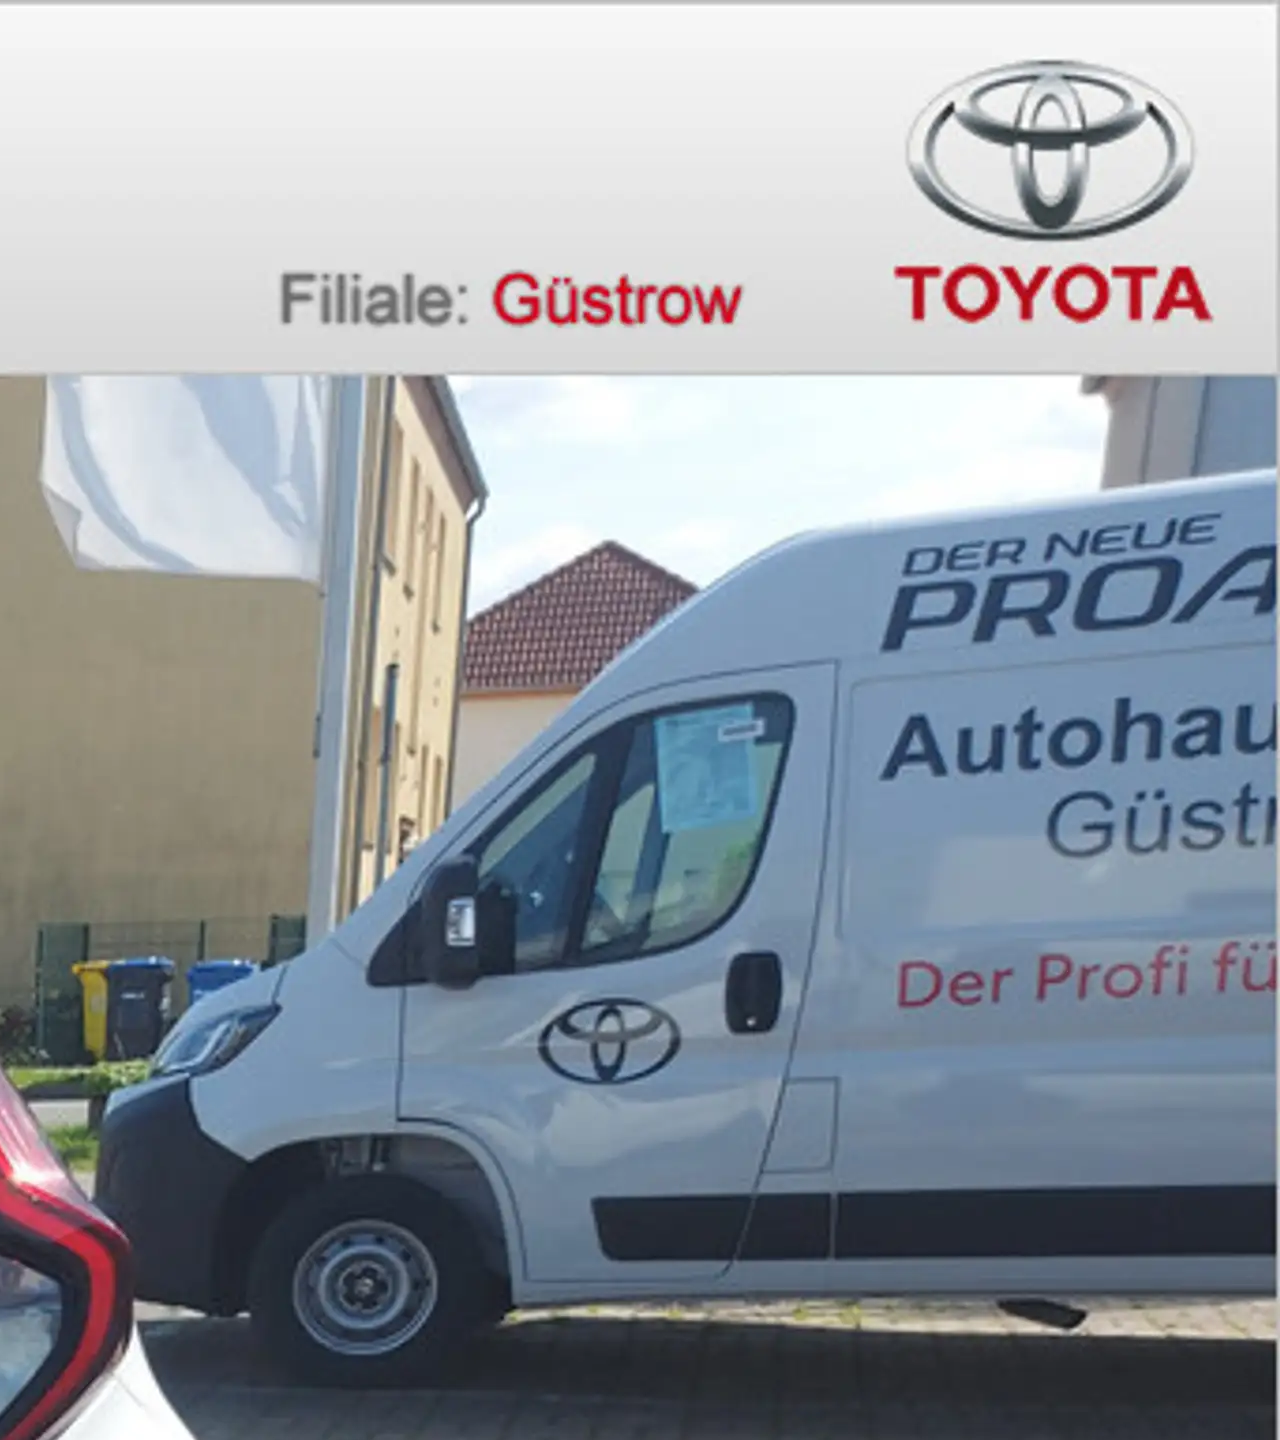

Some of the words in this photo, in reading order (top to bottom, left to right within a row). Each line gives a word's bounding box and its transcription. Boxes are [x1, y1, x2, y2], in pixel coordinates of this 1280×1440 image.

[901, 537, 1027, 577] DER
[1043, 512, 1222, 562] NEUE
[880, 697, 1277, 781] Autohau
[897, 960, 1014, 1009] Der
[1035, 944, 1191, 1002] Profi
